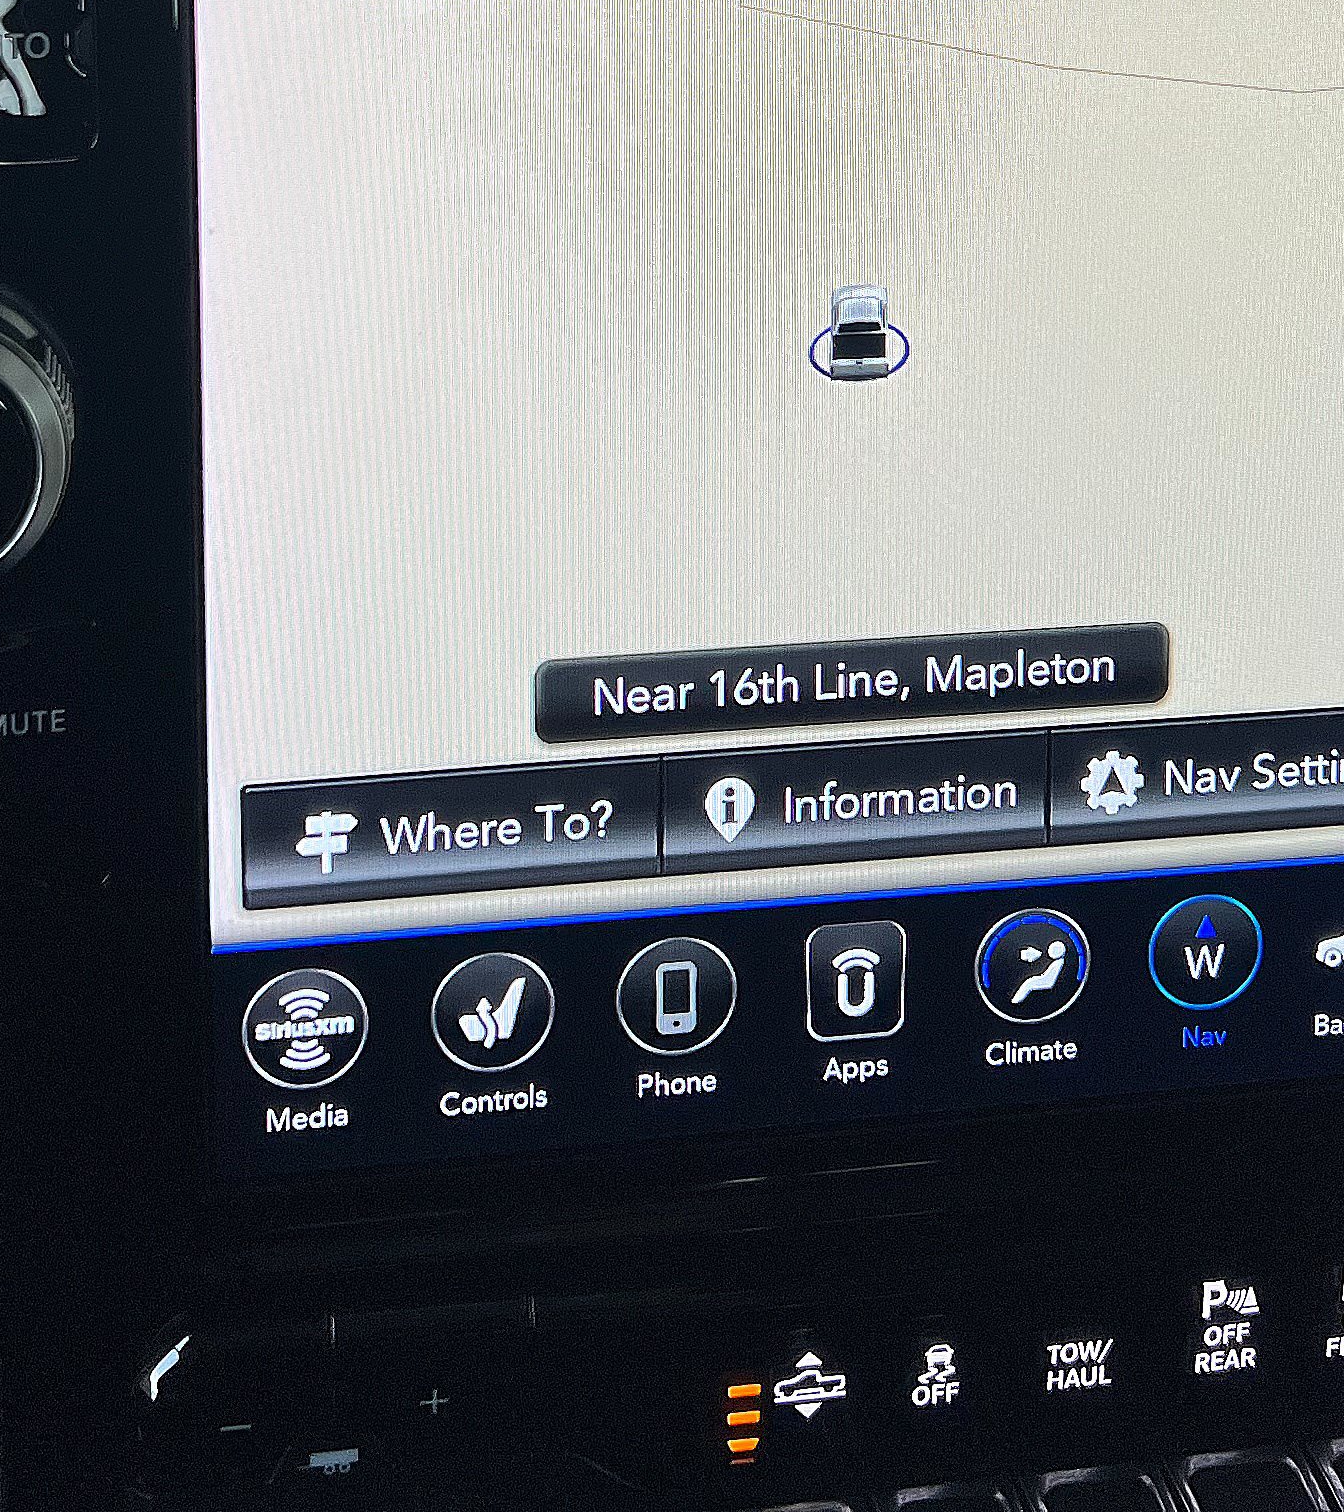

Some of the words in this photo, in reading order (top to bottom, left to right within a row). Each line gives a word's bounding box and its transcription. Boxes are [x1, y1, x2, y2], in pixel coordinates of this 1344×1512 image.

[592, 674, 695, 718] Near
[709, 662, 800, 707] 16th
[814, 661, 912, 703] Line,
[925, 647, 1116, 700] Mapleton
[1163, 758, 1242, 796] Nav
[784, 772, 1018, 826] Information
[380, 810, 522, 857] Where
[534, 799, 614, 843] To?
[1184, 942, 1226, 980] W
[1182, 1025, 1227, 1049] Nav
[985, 1038, 1078, 1067] Climate
[822, 1055, 889, 1084] Apps
[637, 1071, 718, 1098] Phone
[439, 1084, 549, 1118] Controls
[266, 1102, 349, 1133] Media
[1202, 1280, 1228, 1318] P
[1203, 1322, 1250, 1347] OFF
[1047, 1338, 1114, 1367] TOW/
[1194, 1346, 1258, 1374] REAR
[1046, 1364, 1113, 1391] HAUL
[911, 1380, 961, 1407] OFF
